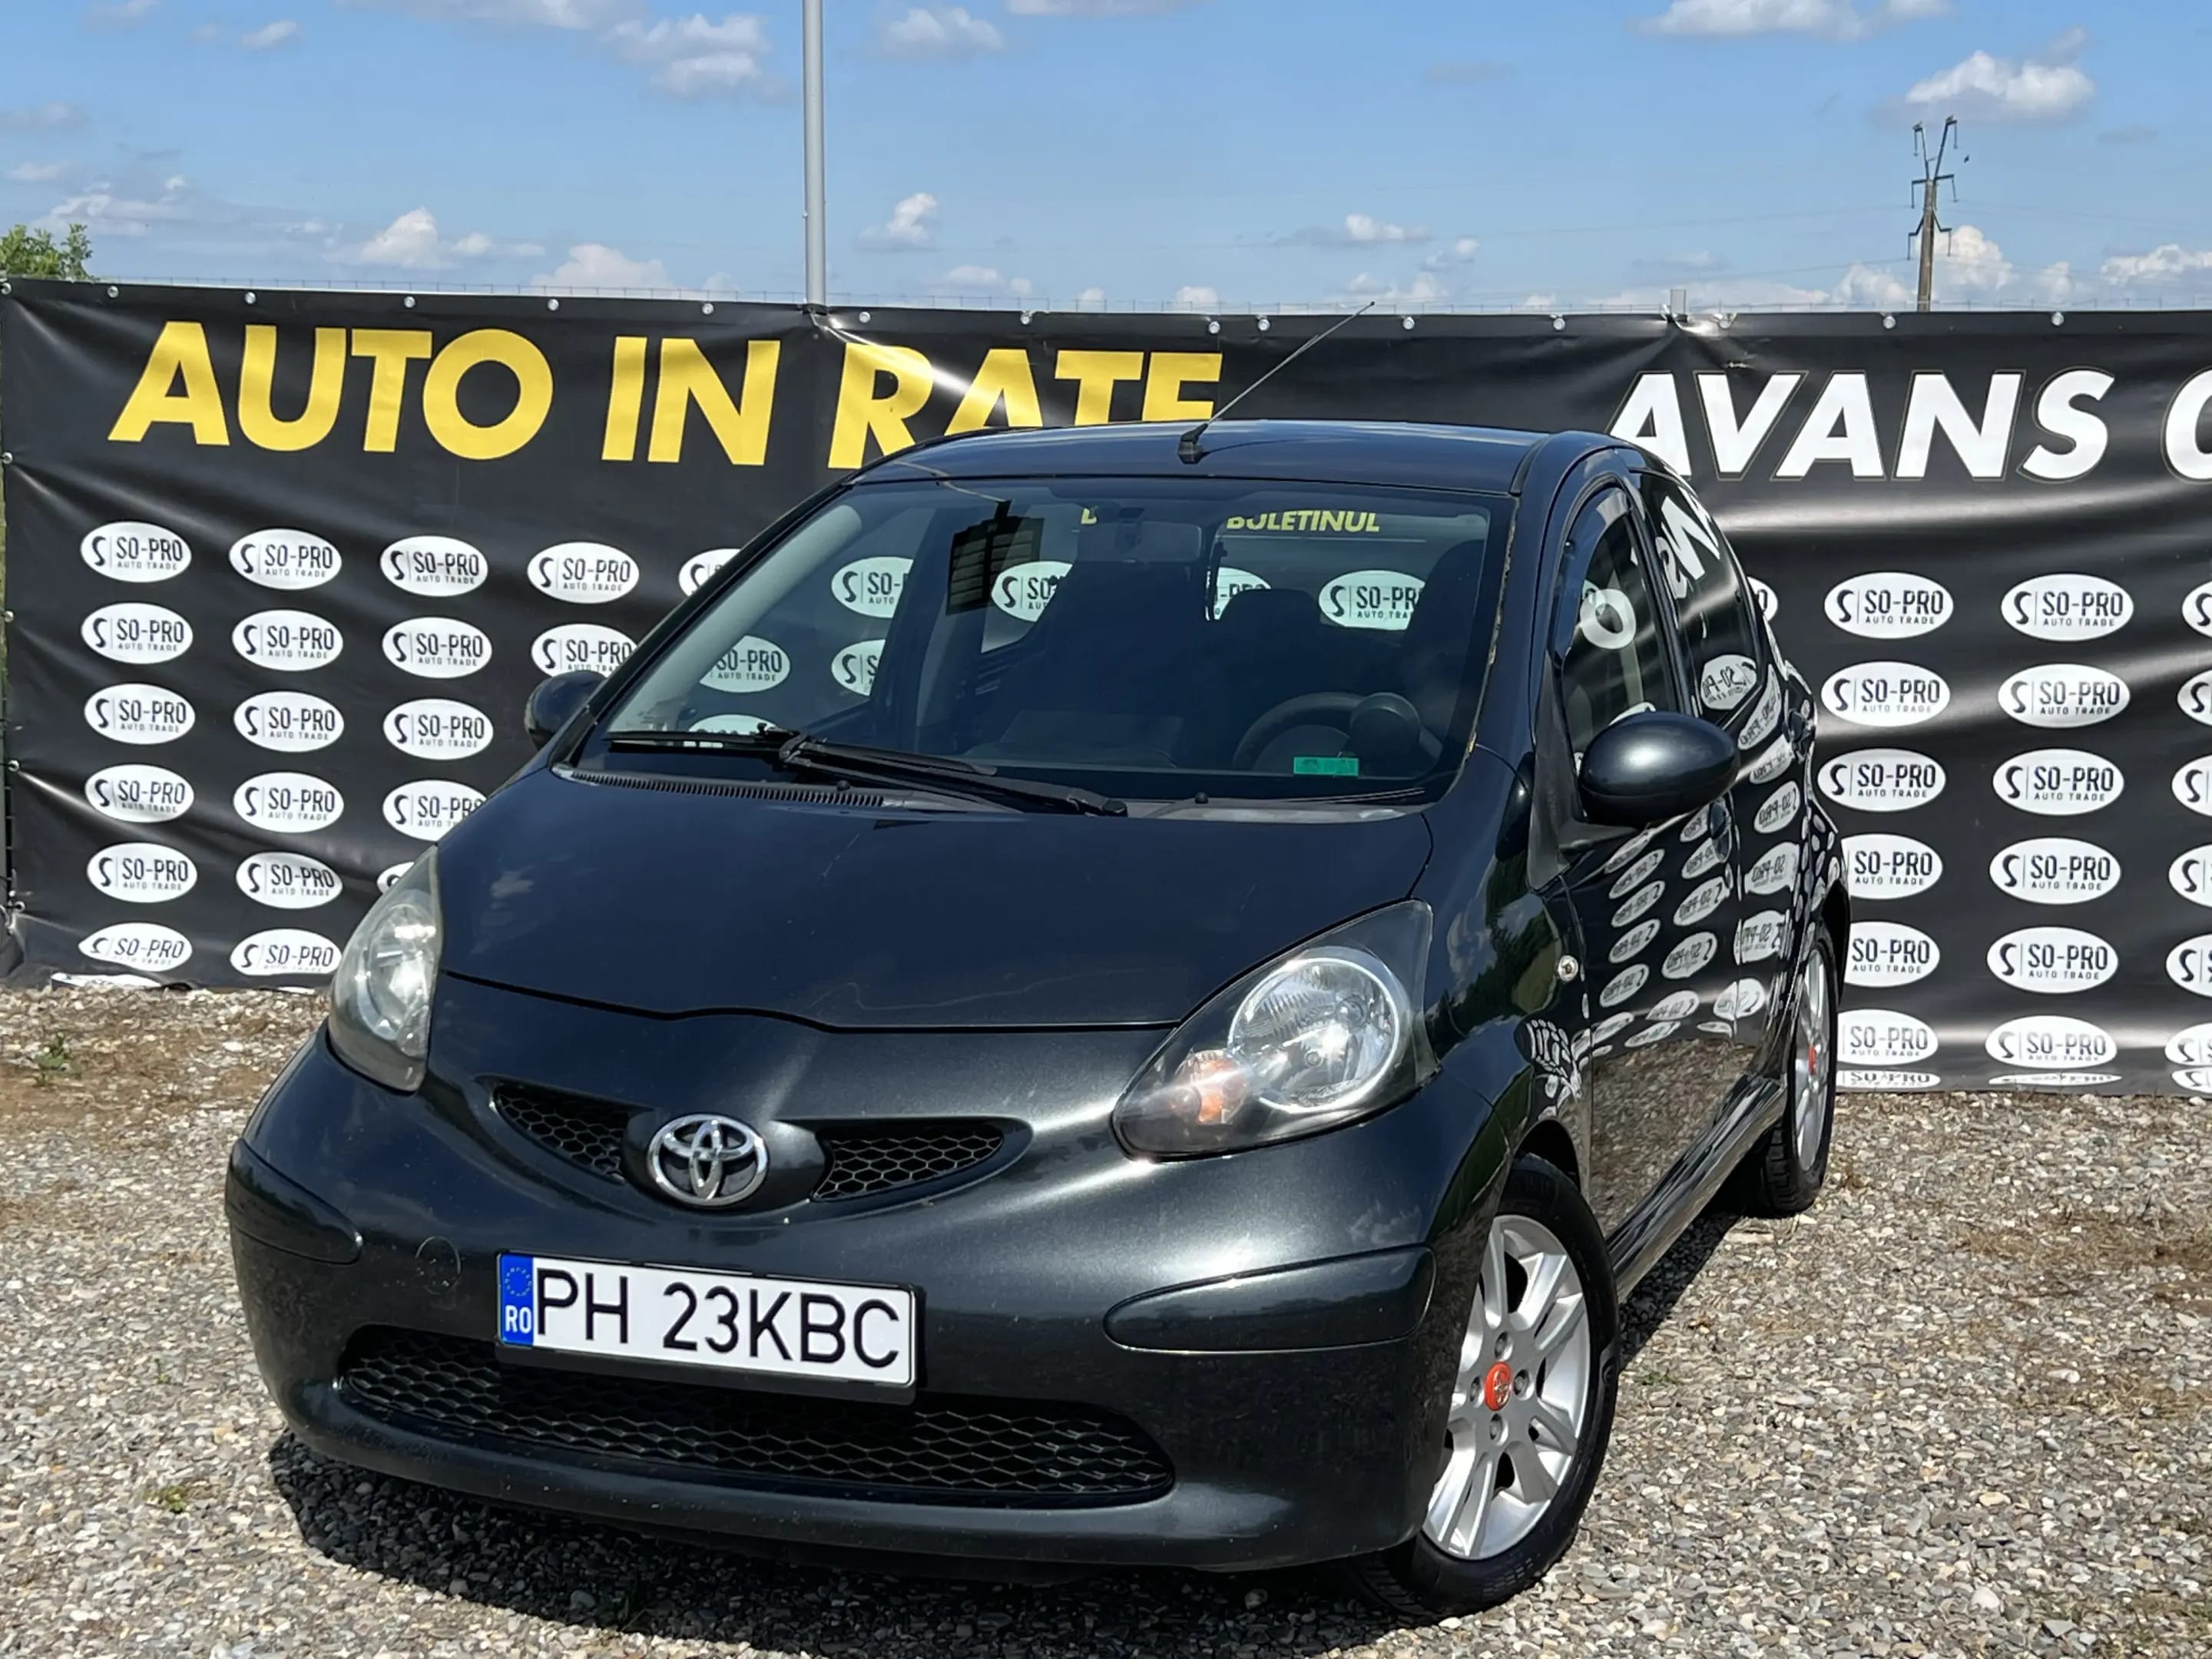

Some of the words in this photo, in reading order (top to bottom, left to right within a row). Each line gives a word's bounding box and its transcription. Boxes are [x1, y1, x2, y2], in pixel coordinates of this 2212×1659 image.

[108, 321, 553, 460] AUTO
[601, 336, 780, 466] IN
[828, 343, 1223, 469] RATE
[1608, 368, 2115, 479] AVANS
[117, 537, 183, 561] SO-PRO
[265, 545, 333, 568] SO-PRO
[118, 561, 142, 569] AUTO
[266, 568, 291, 576] AUTO
[413, 551, 479, 576] SO-PRO
[562, 558, 631, 582] SO-PRO
[416, 575, 441, 584] AUTO
[444, 576, 475, 584] TRADE
[563, 581, 588, 590] AUTO
[1356, 585, 1423, 610] SO-PR
[1865, 590, 1943, 614] SO-PRO
[2042, 591, 2123, 617] SO-PRO
[1357, 611, 1383, 619] AUTO
[1866, 615, 1895, 624] AUTO
[1901, 616, 1934, 624] TRADE
[2043, 618, 2073, 626] AUTO
[2079, 618, 2114, 627] TRADE
[117, 618, 184, 643] SO-PRO
[267, 626, 334, 651] SO-PRO
[118, 642, 142, 651] AUTO
[268, 650, 293, 658] AUTO
[416, 633, 483, 657] SO-PRO
[417, 657, 442, 665] AUTO
[717, 672, 742, 680] AUTO
[747, 673, 776, 682] TRADE
[1862, 679, 1939, 703] SO-PRO
[2040, 682, 2120, 706] SO-PRO
[119, 700, 186, 724] SO-PRO
[269, 707, 335, 731] SO-PRO
[1863, 704, 1891, 712] AUTO
[1897, 704, 1930, 713] TRADE
[2041, 707, 2071, 715] AUTO
[2077, 707, 2111, 716] TRADE
[120, 723, 144, 731] AUTO
[270, 730, 294, 739] AUTO
[419, 714, 484, 739] SO-PRO
[419, 738, 443, 747] AUTO
[1857, 764, 1936, 788] SO-PRO
[2034, 767, 2114, 791] SO-PRO
[118, 780, 185, 805] SO-PRO
[269, 788, 335, 813] SO-PRO
[1858, 789, 1887, 797] AUTO
[1893, 790, 1926, 798] TRADE
[2035, 792, 2065, 800] AUTO
[2071, 793, 2104, 801] TRADE
[121, 803, 145, 811] AUTO
[149, 804, 177, 813] TRADE
[270, 812, 294, 820] AUTO
[123, 858, 188, 882] SO-PRO
[1855, 851, 1932, 876] SO-PRO
[2031, 855, 2110, 880] SO-PRO
[124, 881, 147, 889] AUTO
[271, 866, 336, 889] SO-PRO
[1856, 876, 1884, 885] AUTO
[1890, 877, 1923, 886] TRADE
[2032, 881, 2061, 889] AUTO
[2067, 882, 2101, 890] TRADE
[114, 938, 184, 959] SO-PRO
[269, 945, 334, 967] SO-PRO
[1852, 939, 1929, 964] SO-PRO
[2028, 944, 2108, 970] SO-PRO
[1853, 965, 1881, 973] AUTO
[1887, 965, 1920, 974] TRADE
[2028, 971, 2058, 979] AUTO
[2065, 972, 2098, 980] TRADE
[1850, 1025, 1929, 1050] SO-PRO
[2027, 1031, 2107, 1056] SO-PRO
[505, 1304, 533, 1334] RO
[538, 1267, 628, 1344] PH
[662, 1281, 899, 1369] 23KBC
